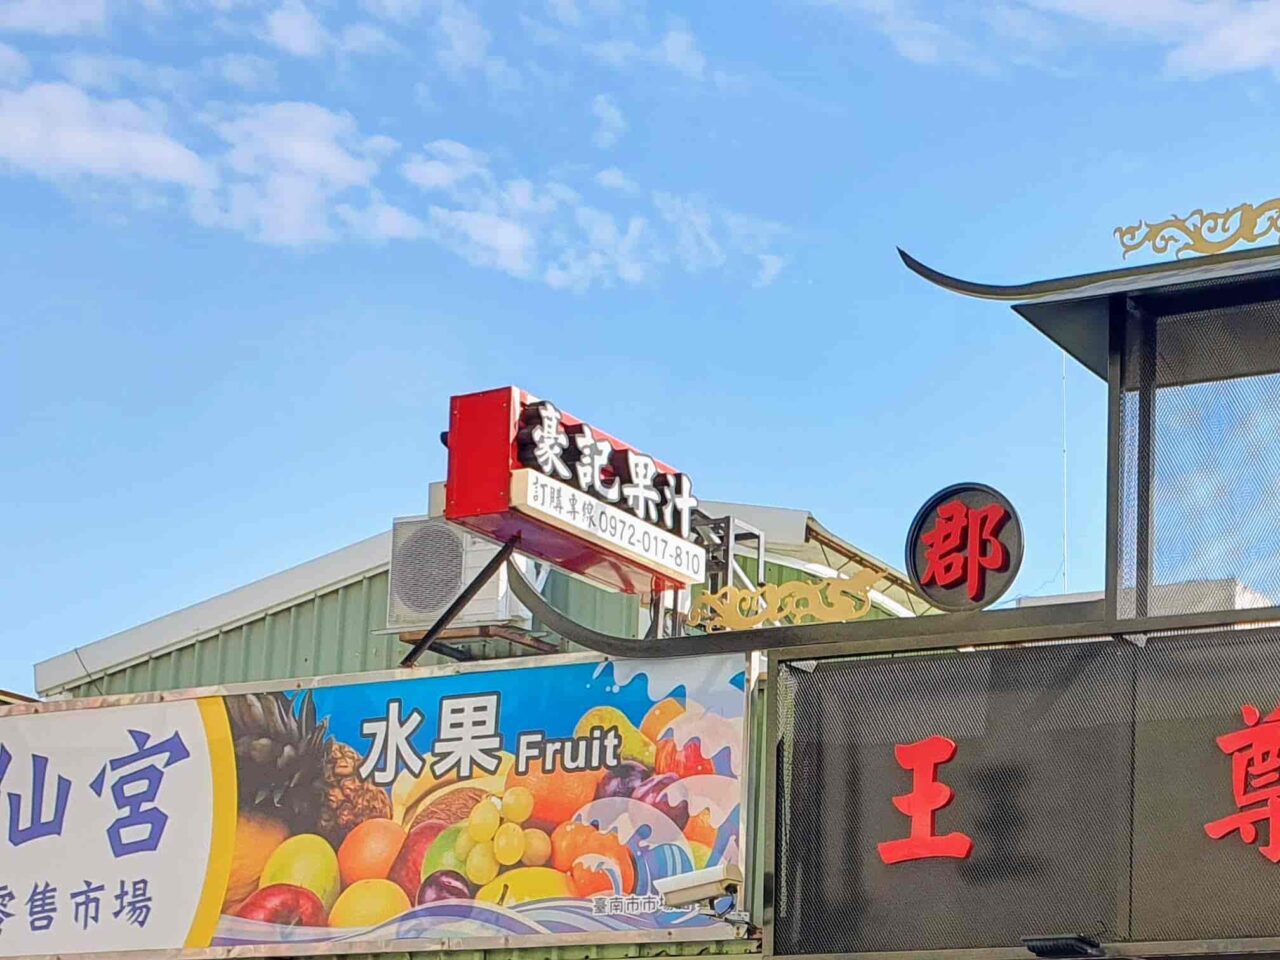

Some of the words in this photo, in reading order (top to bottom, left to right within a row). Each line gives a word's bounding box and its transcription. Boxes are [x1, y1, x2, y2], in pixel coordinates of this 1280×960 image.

[532, 403, 698, 539] 豪記果汁
[920, 499, 1009, 602] 郡
[358, 691, 503, 785] 水果
[516, 726, 622, 775] Fruit
[593, 895, 690, 914] 臺南市市
